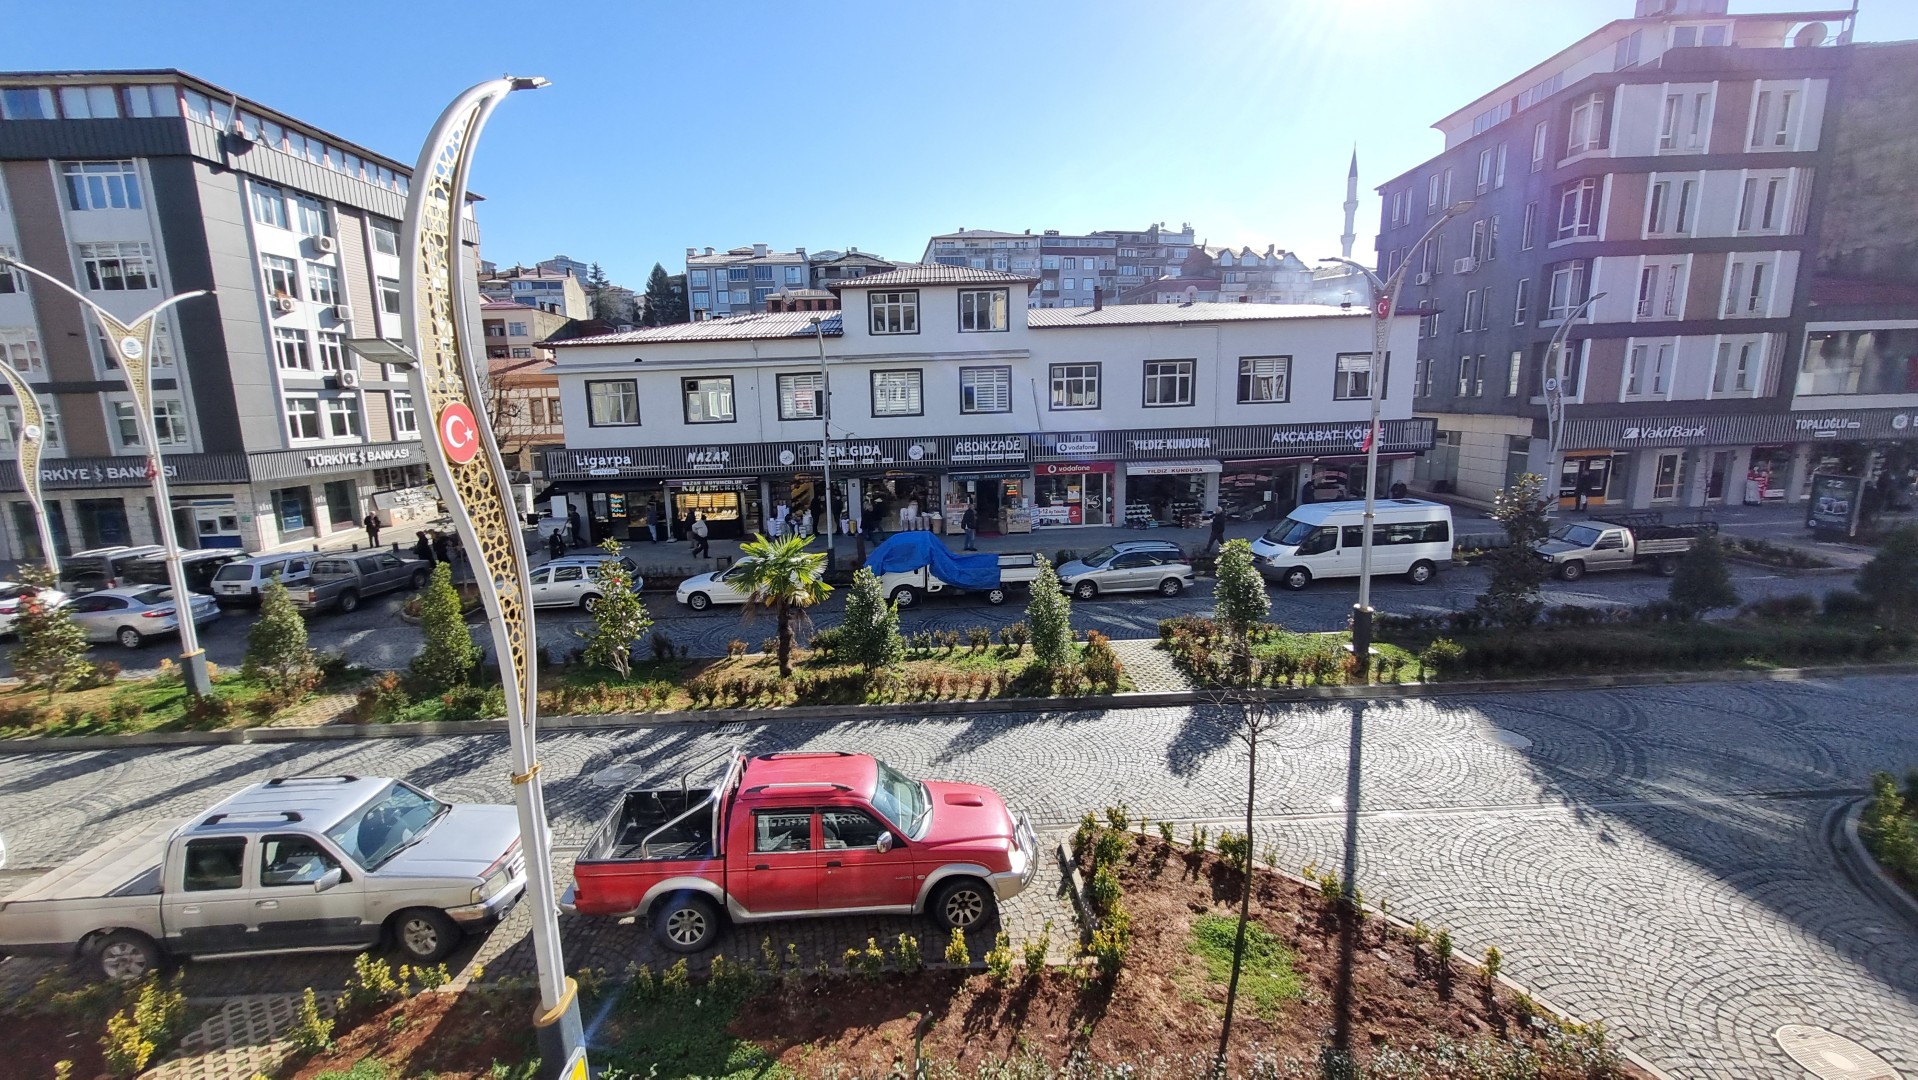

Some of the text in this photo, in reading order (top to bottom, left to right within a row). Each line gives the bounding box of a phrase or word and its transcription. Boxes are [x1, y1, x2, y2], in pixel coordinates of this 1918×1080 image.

[1796, 417, 1848, 430] TOPALOĞLU
[1272, 426, 1385, 443] AKÇAABAT KÖFE
[1641, 425, 1706, 439] VakıfBank
[850, 445, 881, 457] GIDA
[1134, 438, 1210, 451] YILDIZ KUNDURA
[308, 452, 358, 467] TÜRKİYE
[367, 449, 410, 462] BANKASI
[575, 455, 631, 468] Ligarpa
[687, 451, 730, 462] NAZAR
[40, 467, 90, 481] RKİYE
[107, 466, 178, 479] BANKSI
